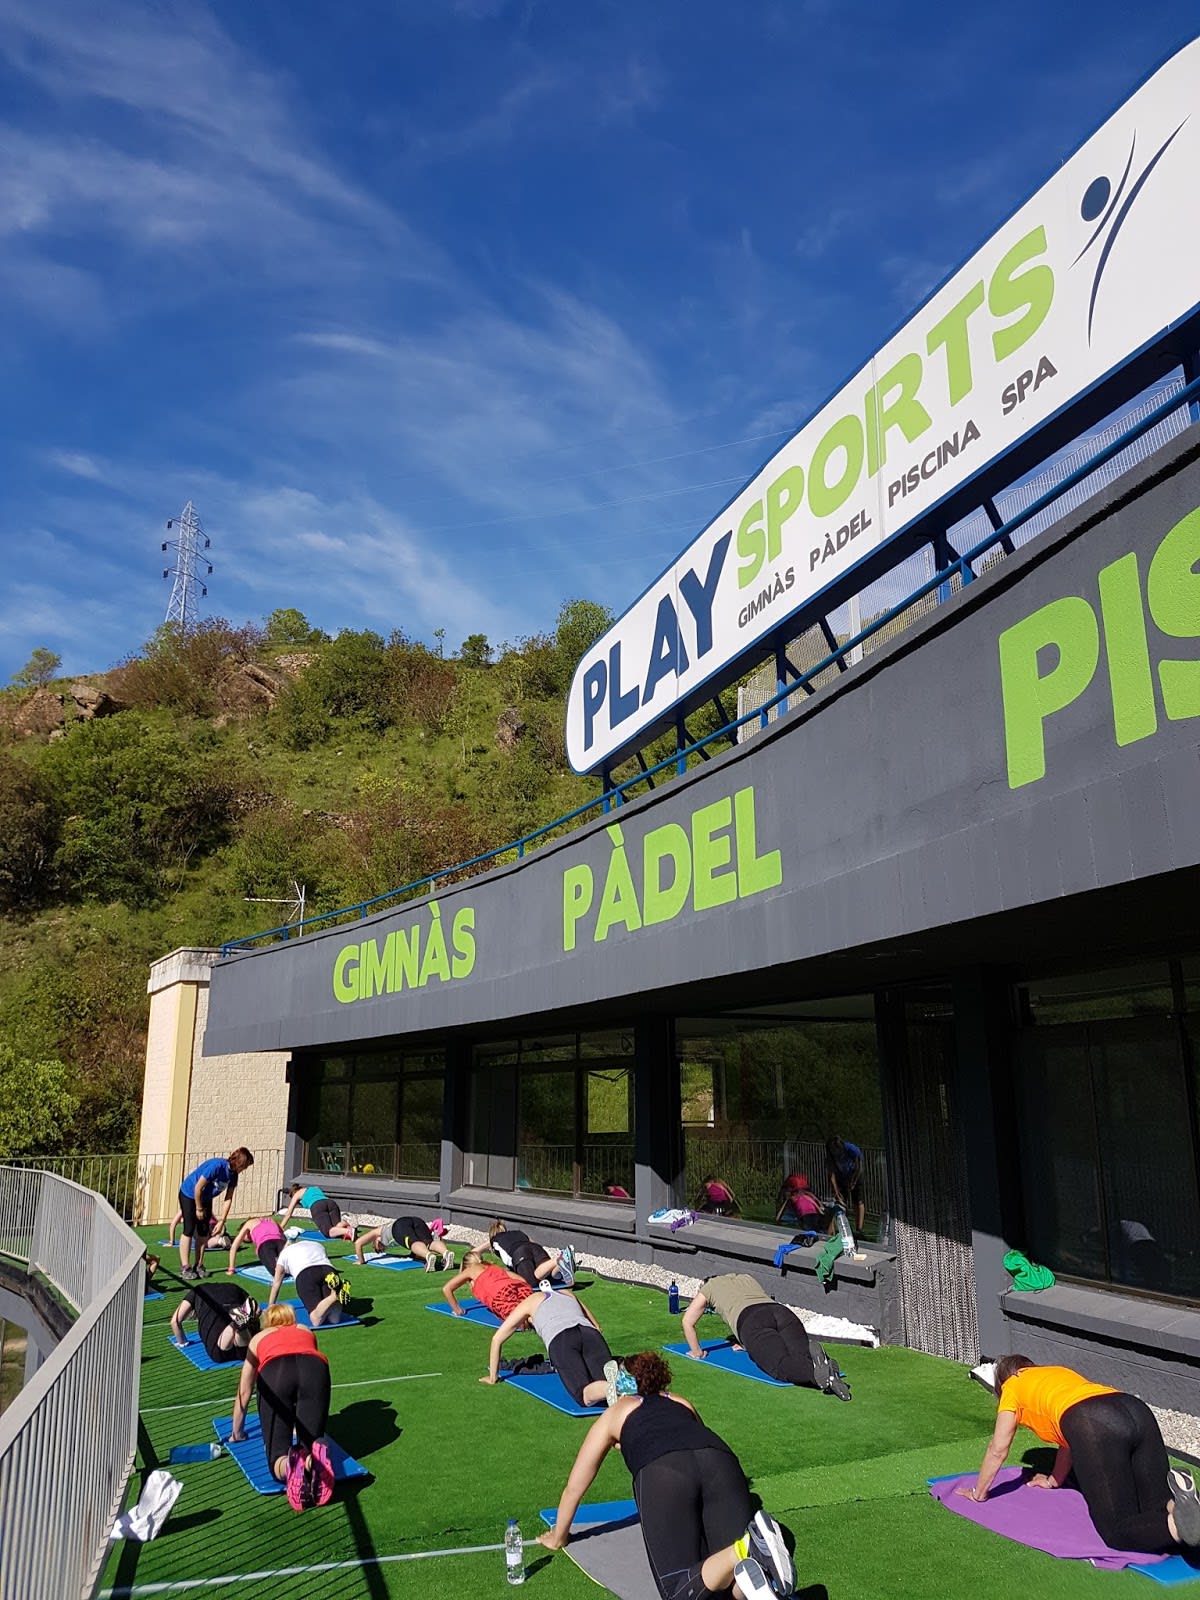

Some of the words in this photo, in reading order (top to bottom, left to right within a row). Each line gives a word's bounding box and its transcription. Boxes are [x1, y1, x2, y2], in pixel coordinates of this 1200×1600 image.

[737, 566, 795, 629] GIMNÀS
[809, 509, 872, 572] PÀDEL
[888, 419, 981, 507] PISCINA
[1001, 355, 1058, 416] SPA
[333, 899, 476, 1004] GIMNÀS
[563, 786, 784, 952] PÀDEL
